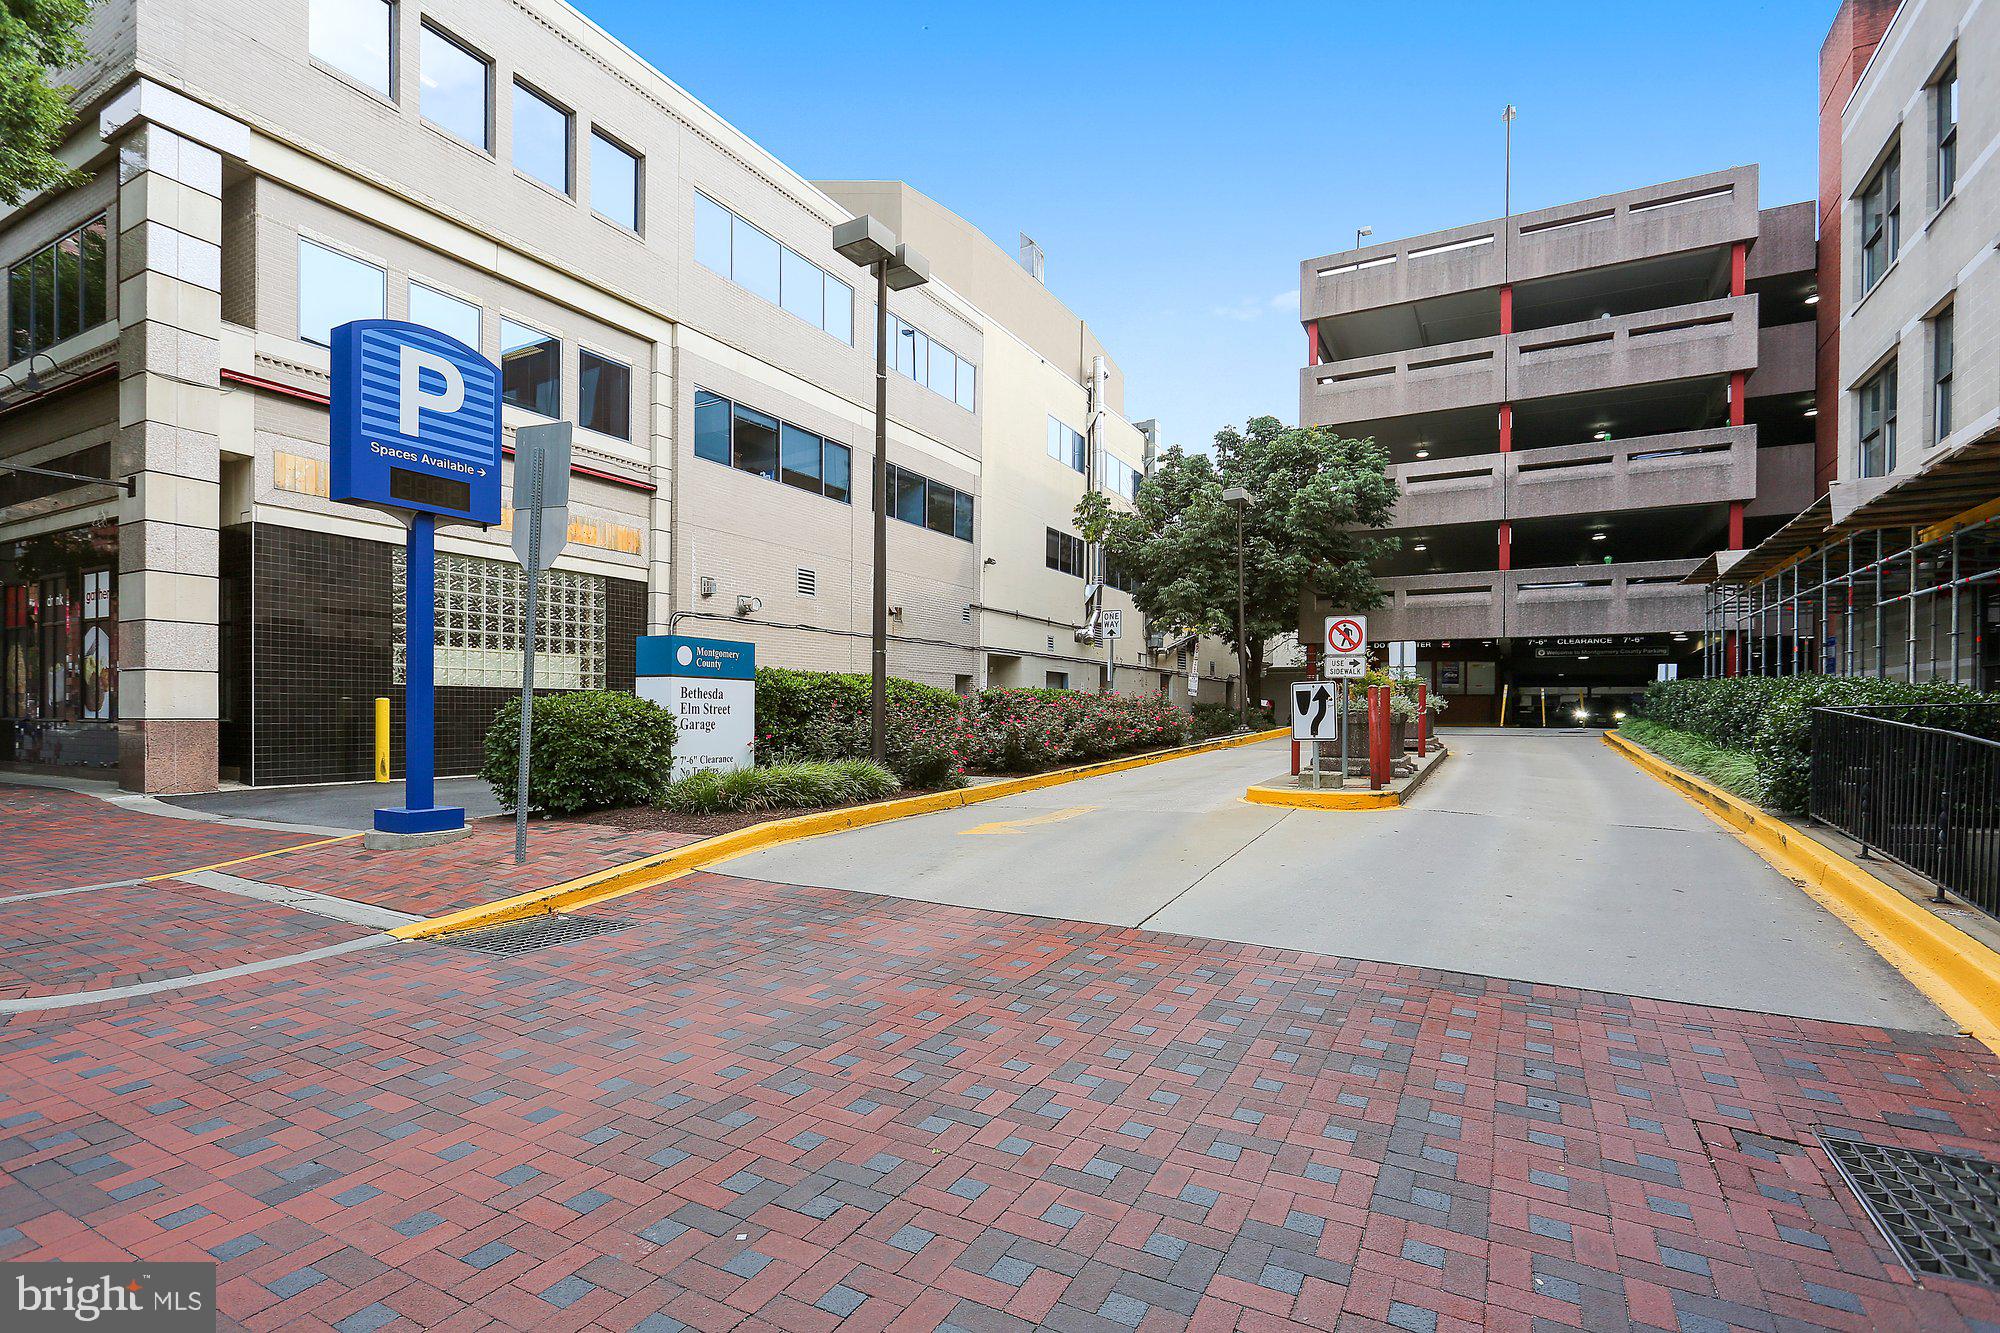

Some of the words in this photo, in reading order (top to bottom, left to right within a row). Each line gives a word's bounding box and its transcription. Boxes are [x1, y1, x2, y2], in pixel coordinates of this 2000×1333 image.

[399, 344, 466, 438] P
[370, 441, 418, 462] Spaces
[421, 453, 475, 475] Available
[1104, 612, 1120, 620] ONE
[1104, 620, 1120, 628] WAY
[1557, 637, 1613, 645] CLEARANCE
[696, 646, 740, 661] Montgomery
[696, 657, 722, 670] County
[1331, 660, 1345, 668] USE
[1329, 667, 1361, 675] SIDEWALK
[680, 686, 724, 700] Bethesda
[680, 702, 700, 715] Elm
[703, 702, 732, 715] Street
[680, 717, 716, 733] Garage
[680, 755, 698, 765] 7'-6"
[700, 754, 734, 765] Clearance
